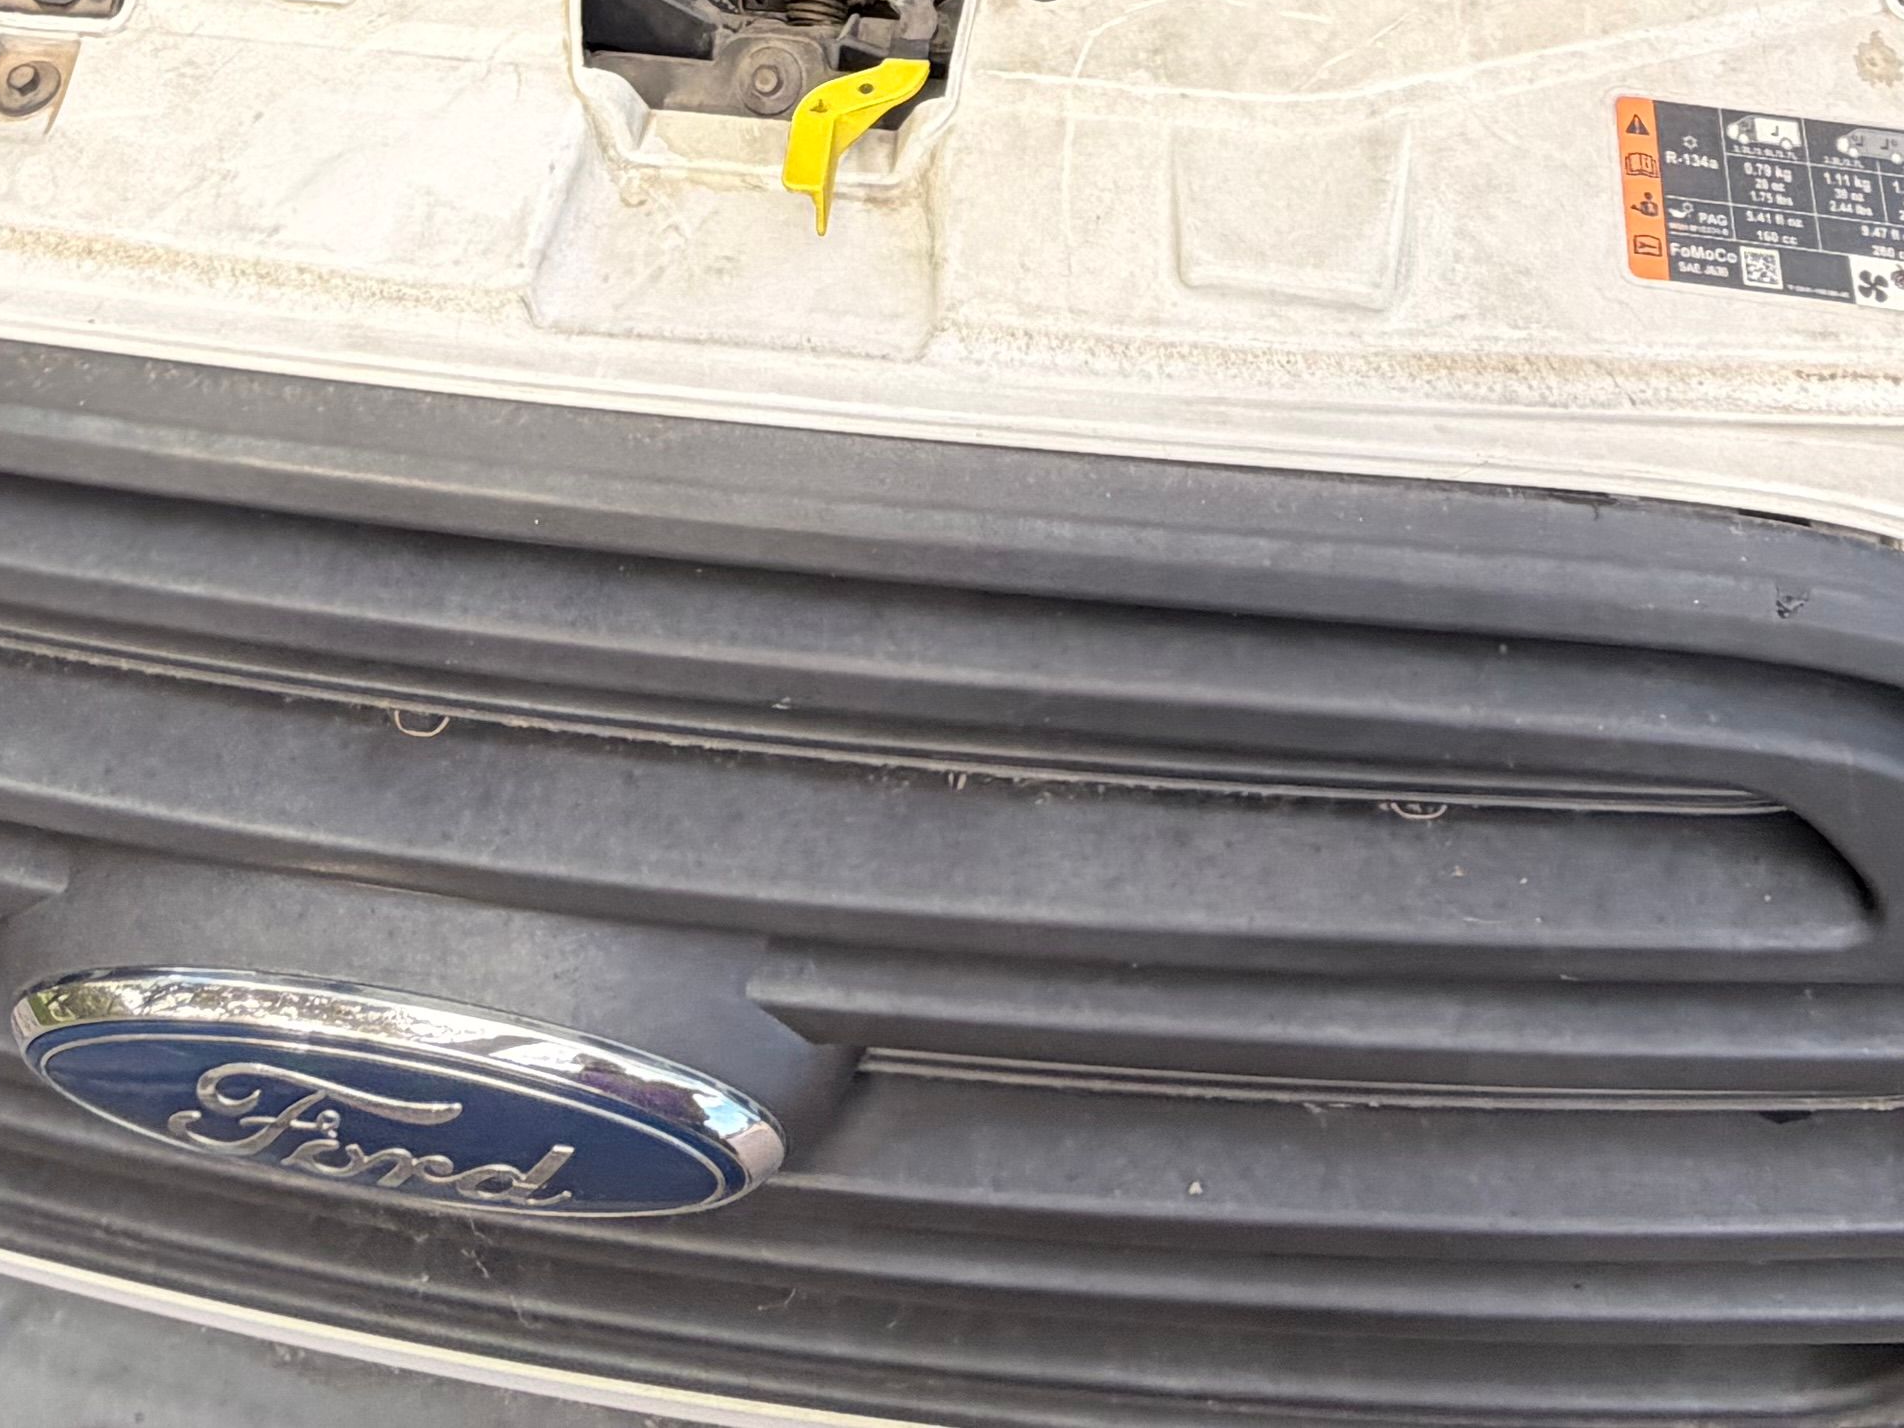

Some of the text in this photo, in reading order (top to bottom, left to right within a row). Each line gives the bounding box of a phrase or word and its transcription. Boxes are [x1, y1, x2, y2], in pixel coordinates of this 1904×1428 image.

[1664, 150, 1720, 170] R-134a
[1743, 161, 1793, 183] 0.79 kg
[1823, 171, 1872, 193] 1.11 kg
[1771, 181, 1786, 192] oz
[1698, 212, 1728, 227] PAG
[1782, 235, 1798, 245] cc
[1669, 241, 1738, 263] FoMoCo
[167, 1062, 574, 1208] Ford
